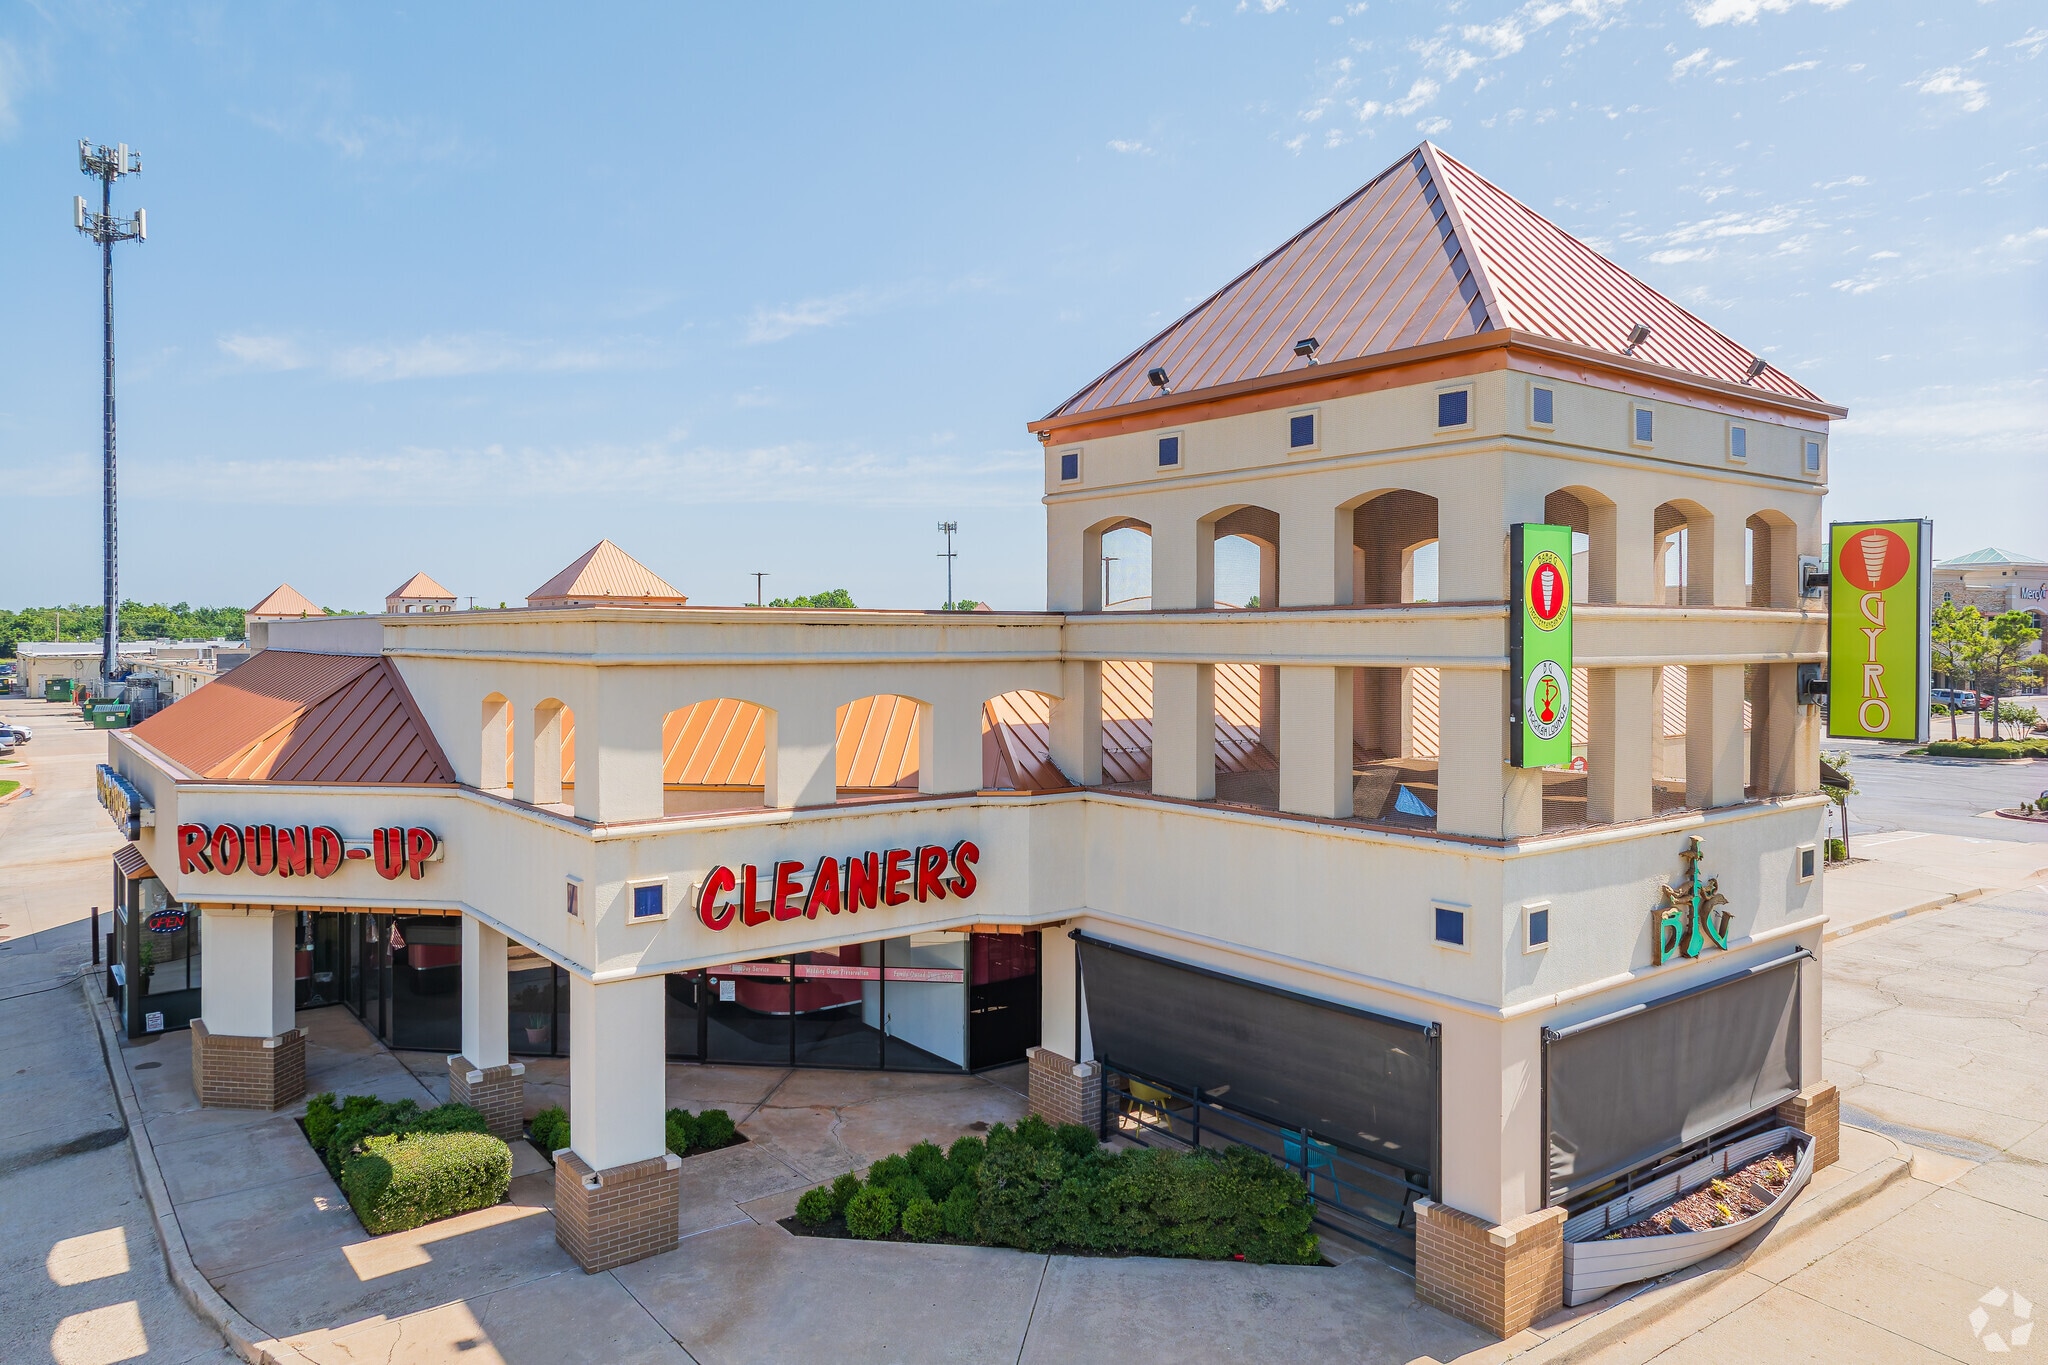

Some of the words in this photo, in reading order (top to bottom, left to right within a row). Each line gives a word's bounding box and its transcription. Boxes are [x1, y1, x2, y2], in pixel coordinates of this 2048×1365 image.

[2020, 587, 2043, 602] Mercy
[1859, 593, 1891, 733] GYRO
[1527, 706, 1548, 737] HOOKAH
[1548, 704, 1568, 737] LOUNGE
[177, 823, 436, 880] ROUND-UP
[698, 840, 979, 931] CLEANERS
[149, 916, 185, 929] OPEN
